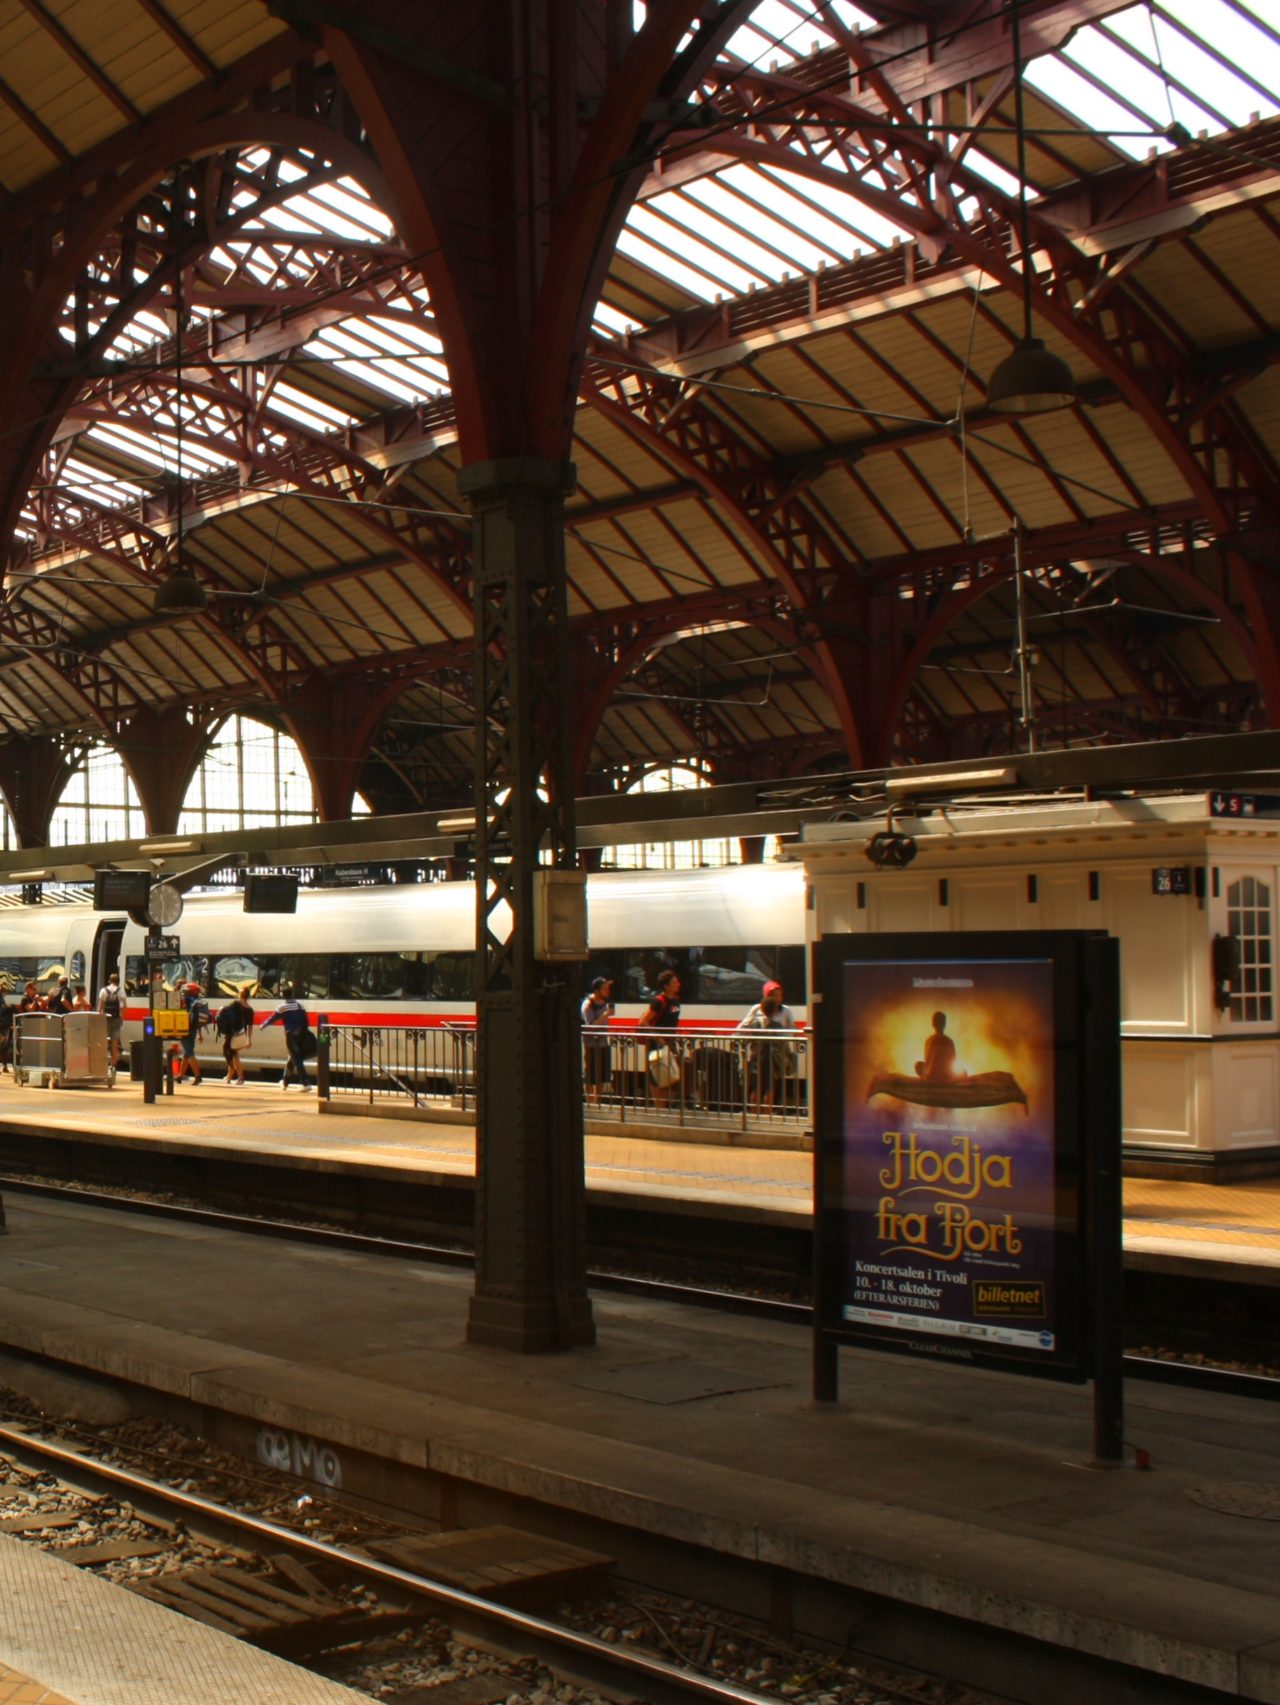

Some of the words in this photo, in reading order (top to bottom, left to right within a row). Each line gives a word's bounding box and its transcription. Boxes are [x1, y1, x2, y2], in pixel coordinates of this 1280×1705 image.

[1158, 877, 1171, 890] 26
[158, 940, 168, 949] 26
[202, 958, 209, 974] 2
[879, 1131, 1013, 1200] Hodja
[874, 1196, 928, 1244] fra
[933, 1201, 1022, 1261] Pjort
[855, 1260, 926, 1280] Koncertsalen
[927, 1266, 932, 1281] i
[934, 1268, 968, 1286] Tivoli
[855, 1276, 871, 1289] 10.
[880, 1278, 897, 1292] 18.
[899, 1282, 943, 1298] oktober
[977, 1286, 1041, 1304] billetnet
